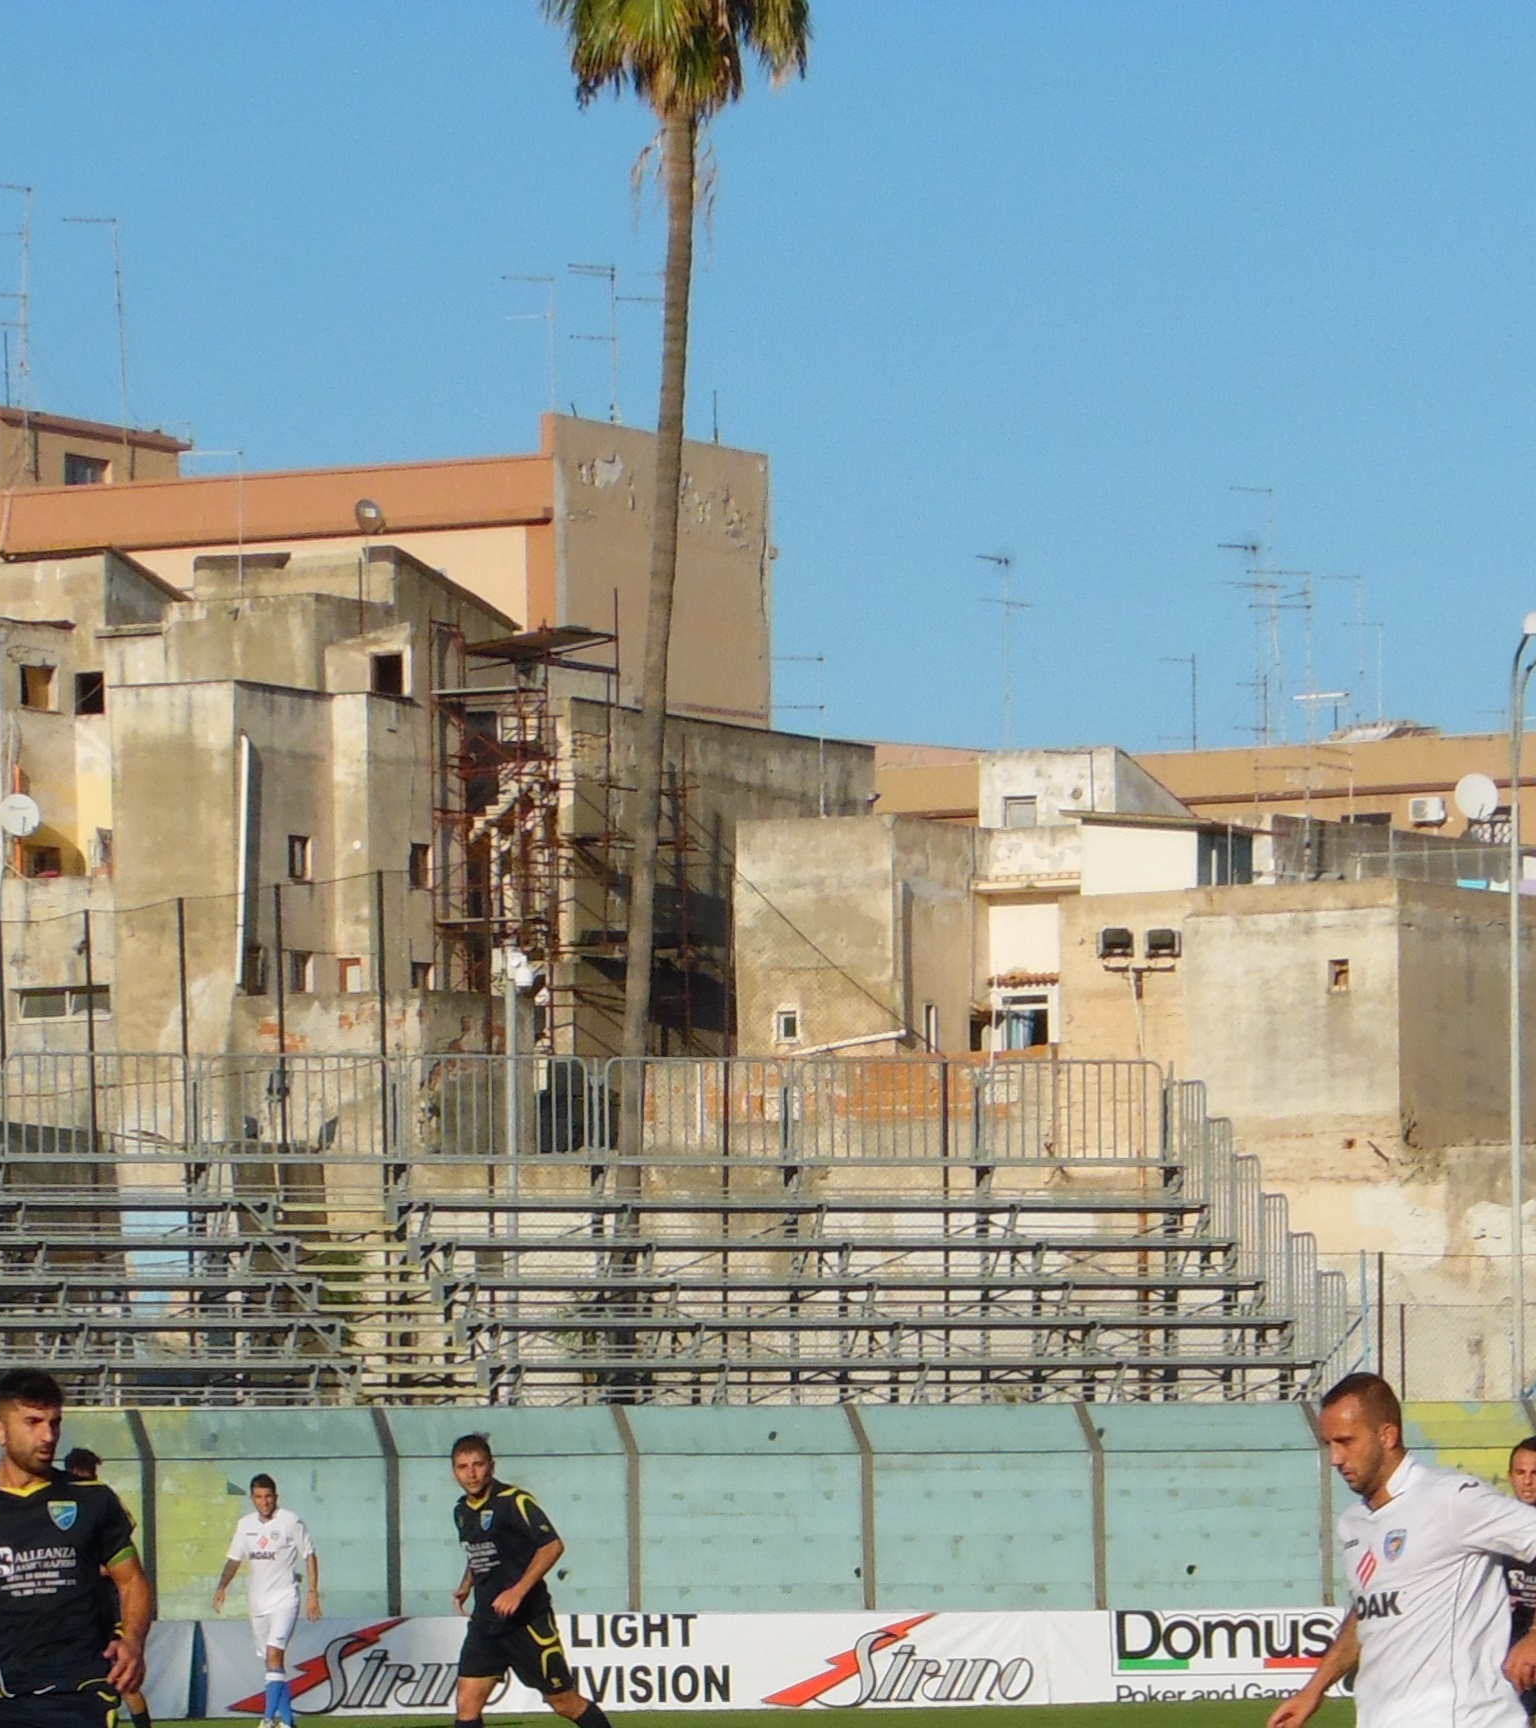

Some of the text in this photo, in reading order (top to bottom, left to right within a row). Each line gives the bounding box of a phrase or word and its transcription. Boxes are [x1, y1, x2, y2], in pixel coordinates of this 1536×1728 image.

[14, 1547, 77, 1563] ALLEANZA
[570, 1614, 698, 1648] LIGHT
[1116, 1610, 1336, 1660] Domus
[570, 1664, 730, 1703] IVISION
[814, 1629, 1034, 1707] Strano
[1116, 1684, 1185, 1701] Poker
[1191, 1684, 1235, 1699] and
